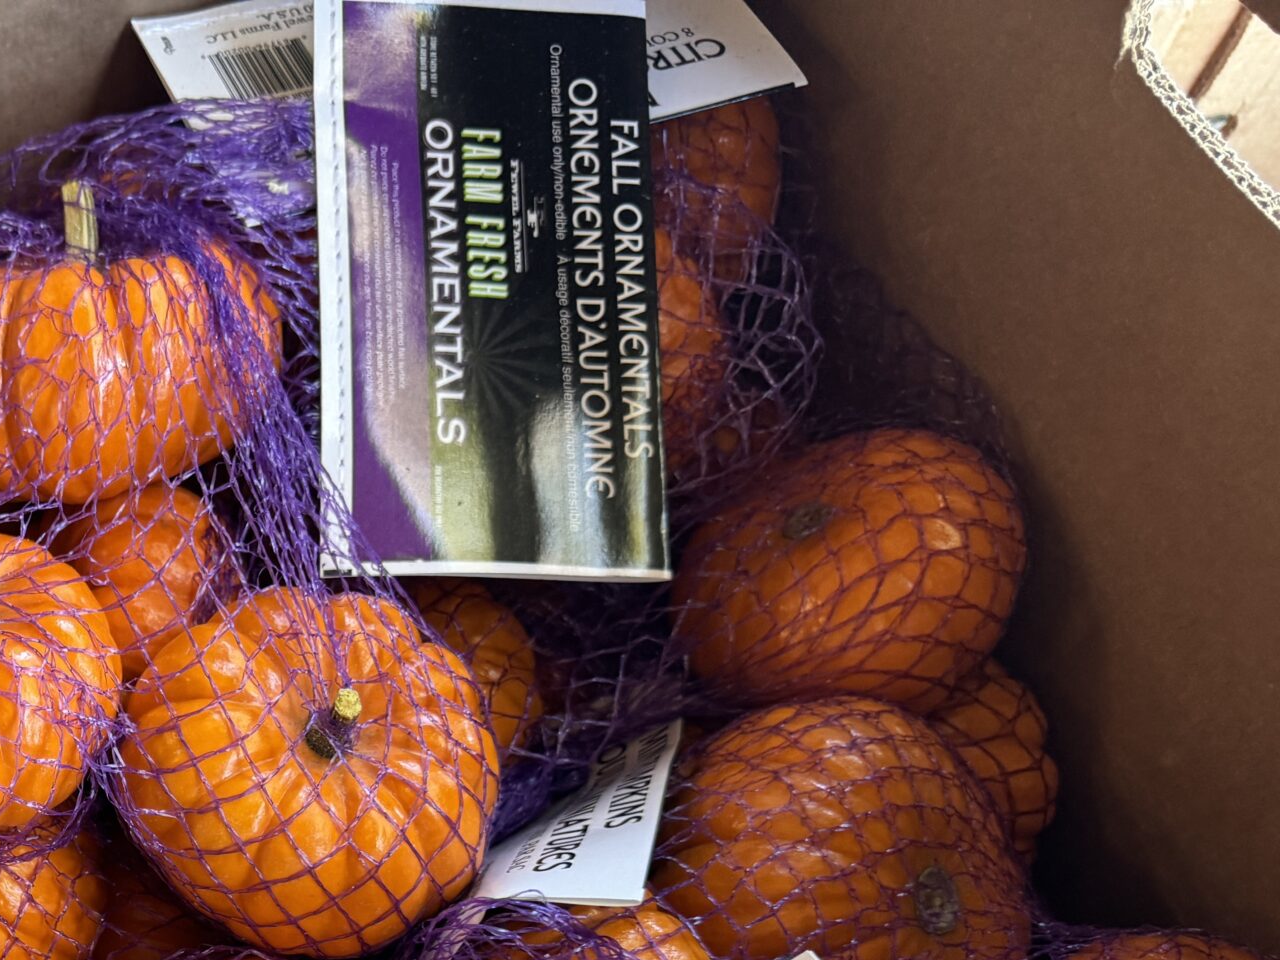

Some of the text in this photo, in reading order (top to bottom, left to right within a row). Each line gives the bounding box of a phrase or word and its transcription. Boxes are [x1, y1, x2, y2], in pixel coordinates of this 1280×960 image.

[547, 43, 563, 117] Ornamental
[646, 38, 726, 70] CITR
[550, 119, 562, 143] use
[459, 125, 510, 301] FARM FRESH
[548, 145, 569, 240] only/non-edible
[422, 117, 468, 445] ORNAMENTALS
[553, 267, 569, 306] usage
[564, 77, 616, 500] ORNEMENTS D'AUTOMNE
[607, 118, 655, 459] FALL ORNAMENTALS
